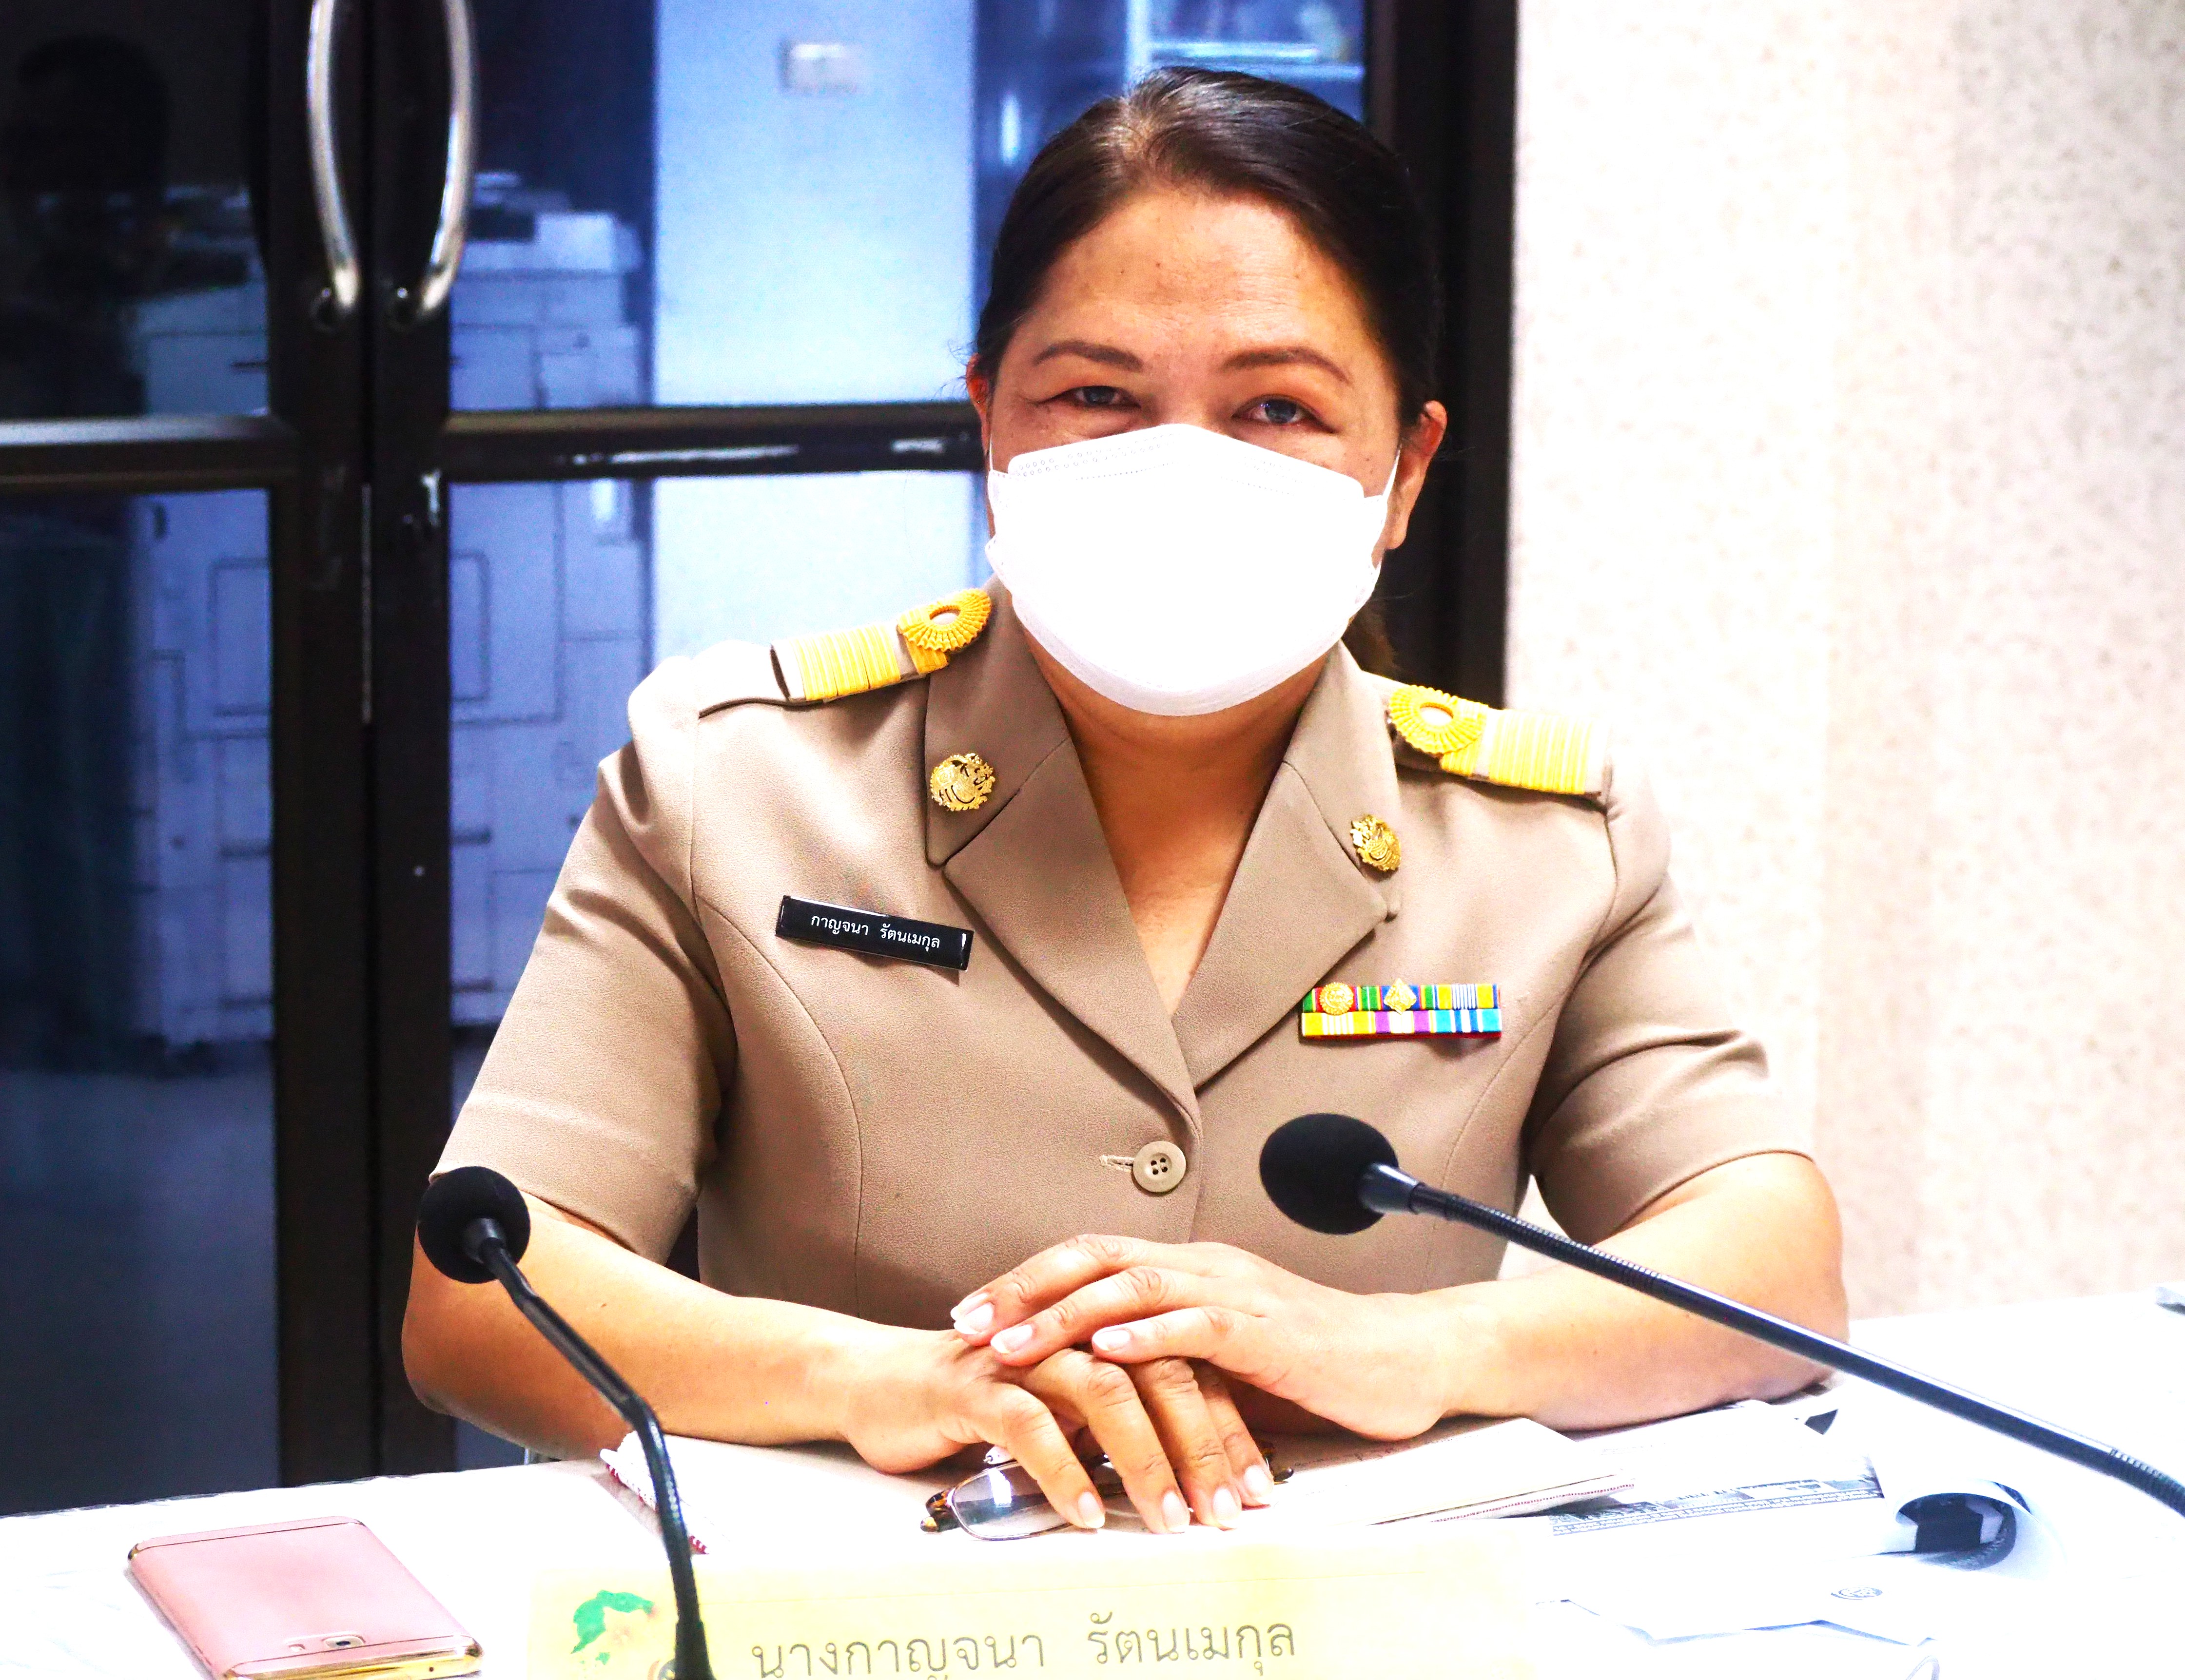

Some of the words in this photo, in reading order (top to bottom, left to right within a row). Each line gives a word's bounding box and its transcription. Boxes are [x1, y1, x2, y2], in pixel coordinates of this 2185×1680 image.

[811, 915, 869, 935] กาญจนา
[879, 924, 940, 952] รัตนเมกุล
[752, 1634, 1044, 1680] นางกาญจนา
[1087, 1611, 1295, 1676] รัตนเมกุล
